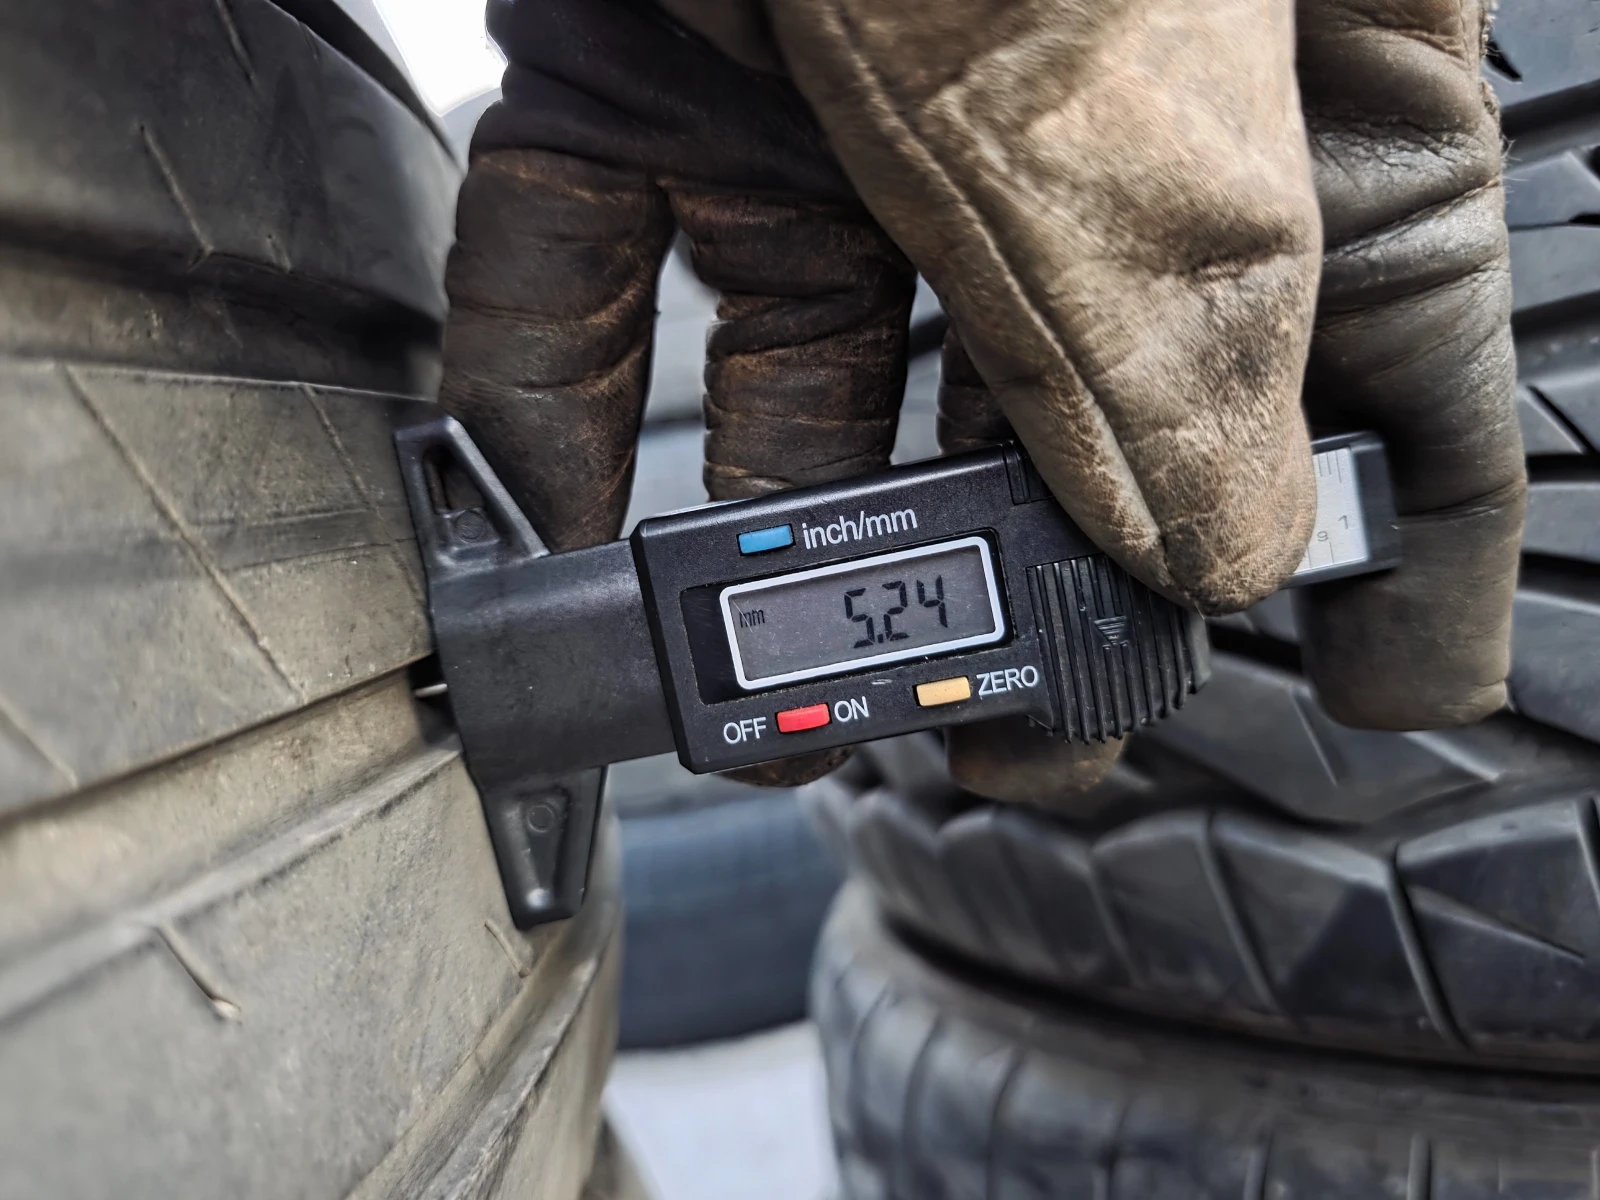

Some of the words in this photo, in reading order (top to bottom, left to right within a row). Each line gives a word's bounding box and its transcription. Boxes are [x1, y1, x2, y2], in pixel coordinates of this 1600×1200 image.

[803, 508, 918, 549] inch/mm
[738, 608, 766, 629] mm
[844, 574, 948, 648] 5.24
[976, 665, 1039, 695] ZERO
[834, 695, 869, 724] ON
[723, 716, 767, 745] OFF
